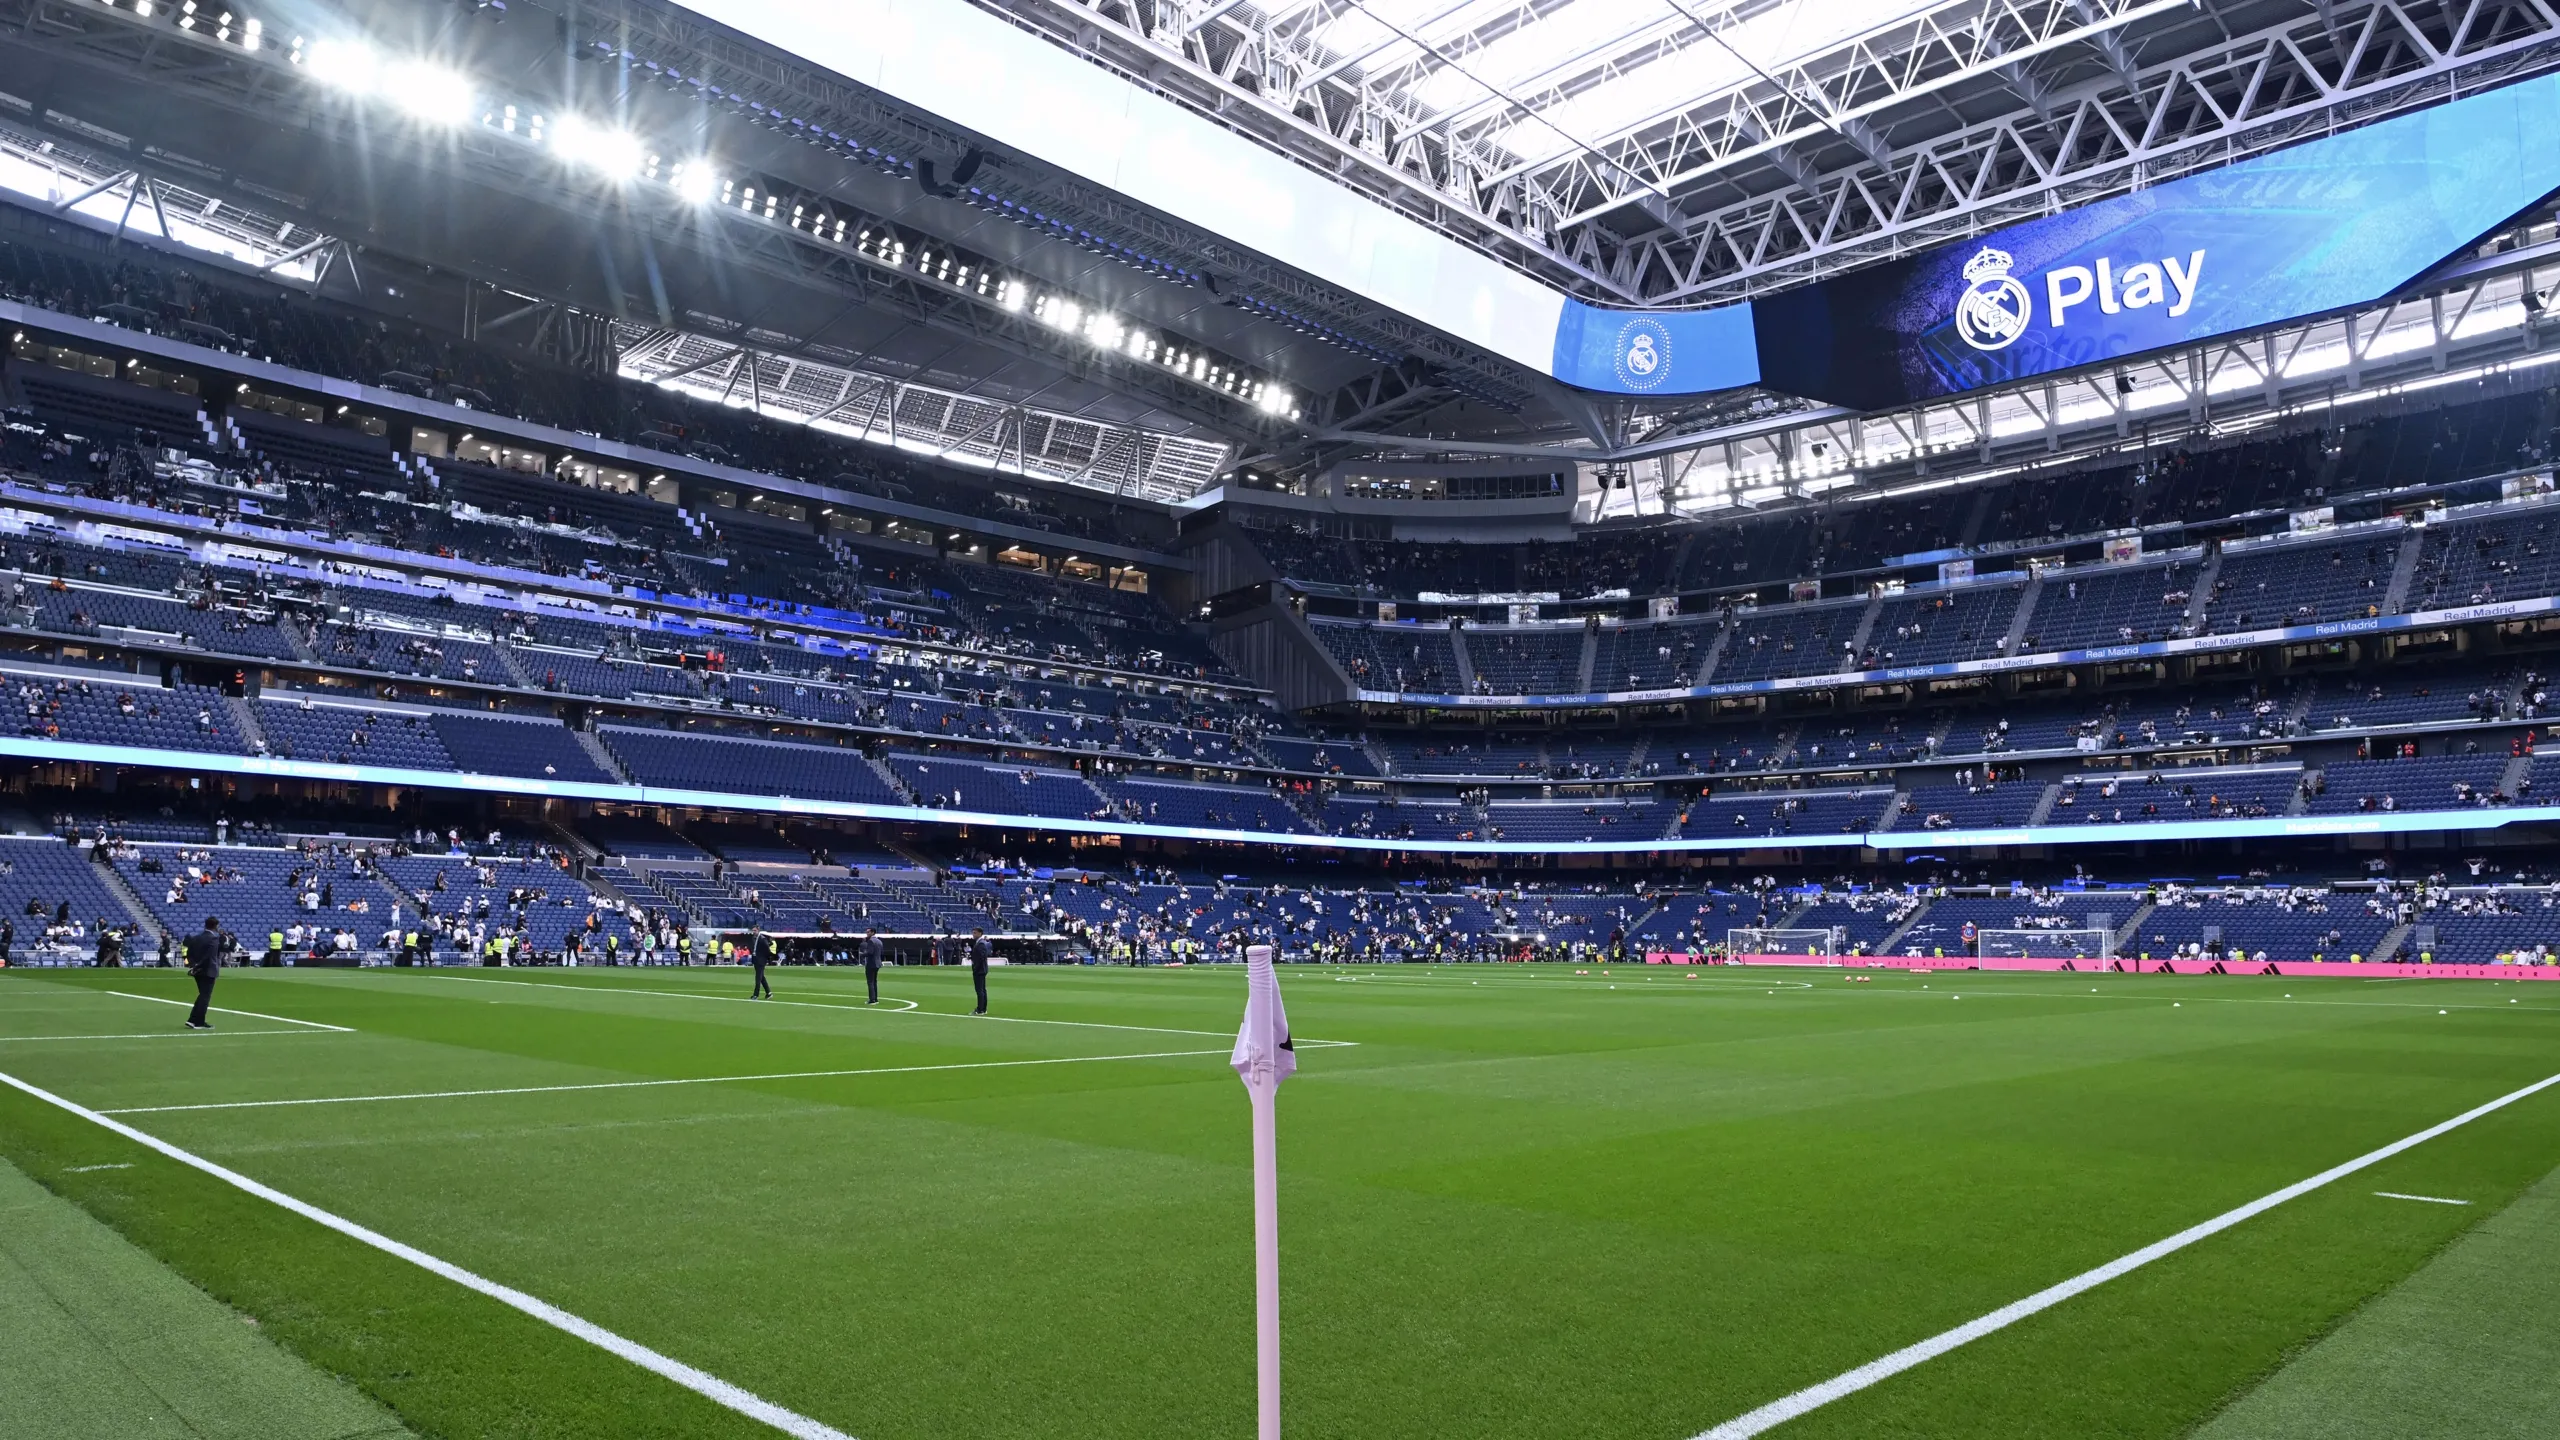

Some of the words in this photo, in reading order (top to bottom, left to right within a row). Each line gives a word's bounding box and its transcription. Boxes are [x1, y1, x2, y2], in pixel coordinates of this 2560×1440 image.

[2047, 249, 2205, 328] Play
[2444, 612, 2470, 620] Real
[2473, 604, 2516, 617] Madrid
[2315, 626, 2338, 634] Real
[2340, 620, 2378, 631] Madrid
[2195, 640, 2217, 648] Real
[2219, 635, 2255, 646] Madrid
[2086, 650, 2105, 659] Real
[2107, 646, 2139, 656] Madrid
[2002, 659, 2033, 668] Madrid
[1905, 668, 1933, 676] Madrid
[1813, 677, 1841, 686] Madrid
[1727, 684, 1753, 692] Madrid
[1645, 692, 1670, 700] Madrid
